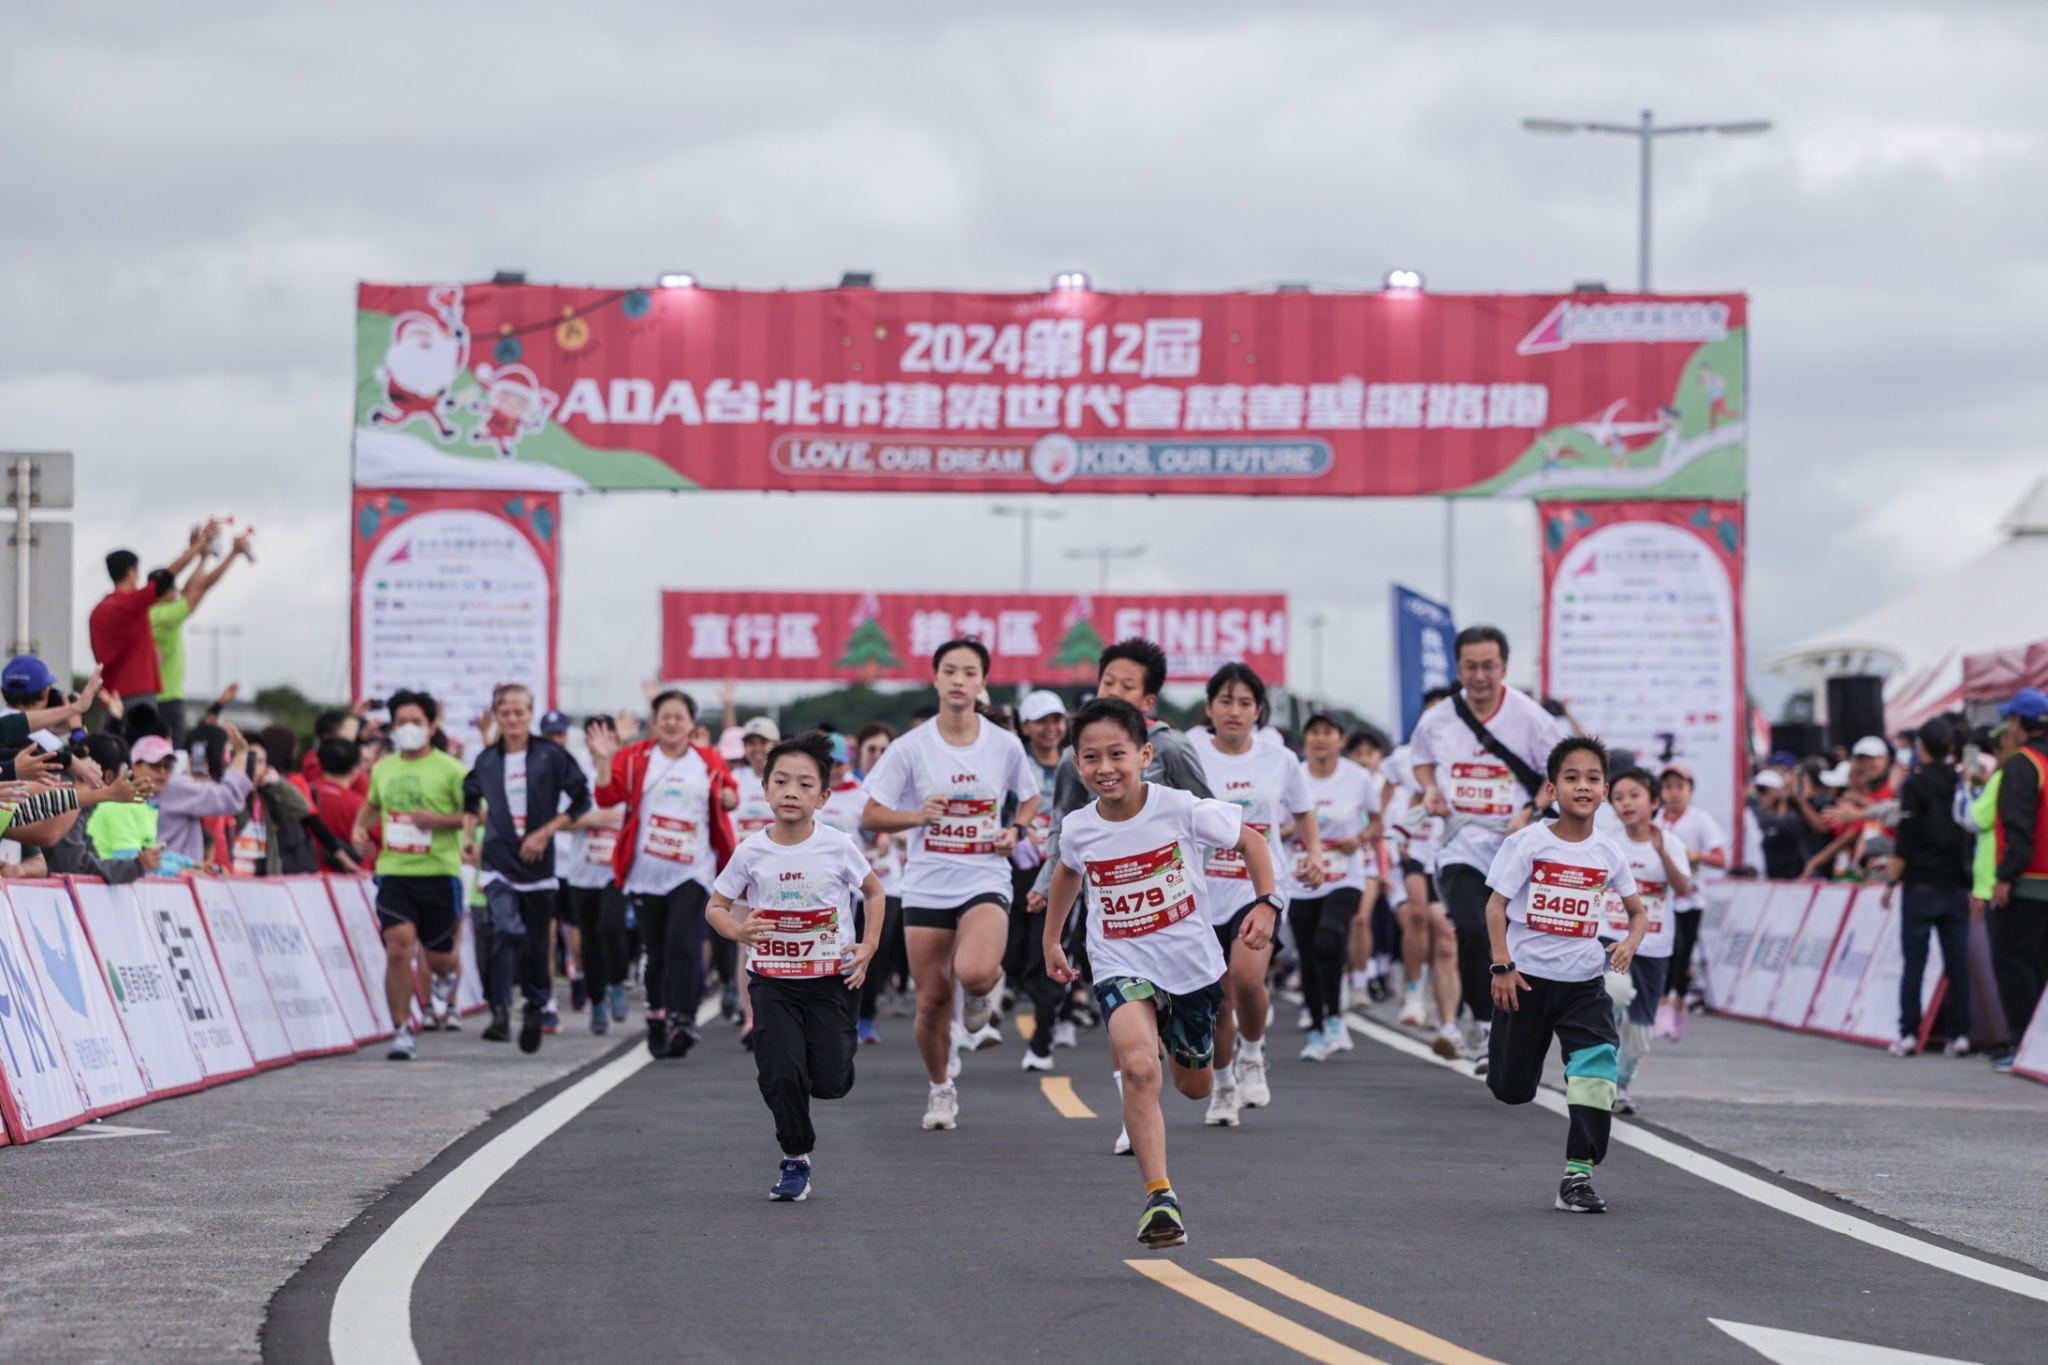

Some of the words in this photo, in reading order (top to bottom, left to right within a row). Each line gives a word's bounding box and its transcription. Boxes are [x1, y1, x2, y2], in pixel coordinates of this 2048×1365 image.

[901, 319, 1201, 378] 2024第12屆
[878, 446, 933, 472] OUR
[936, 447, 1025, 474] DREAM
[1157, 447, 1213, 473] OUR
[1215, 446, 1314, 473] FUTURE
[688, 612, 821, 660] 直行區
[1113, 606, 1285, 656] FINISH
[928, 821, 978, 839] 3449
[1101, 887, 1165, 916] 3479
[1532, 893, 1590, 917] 3480
